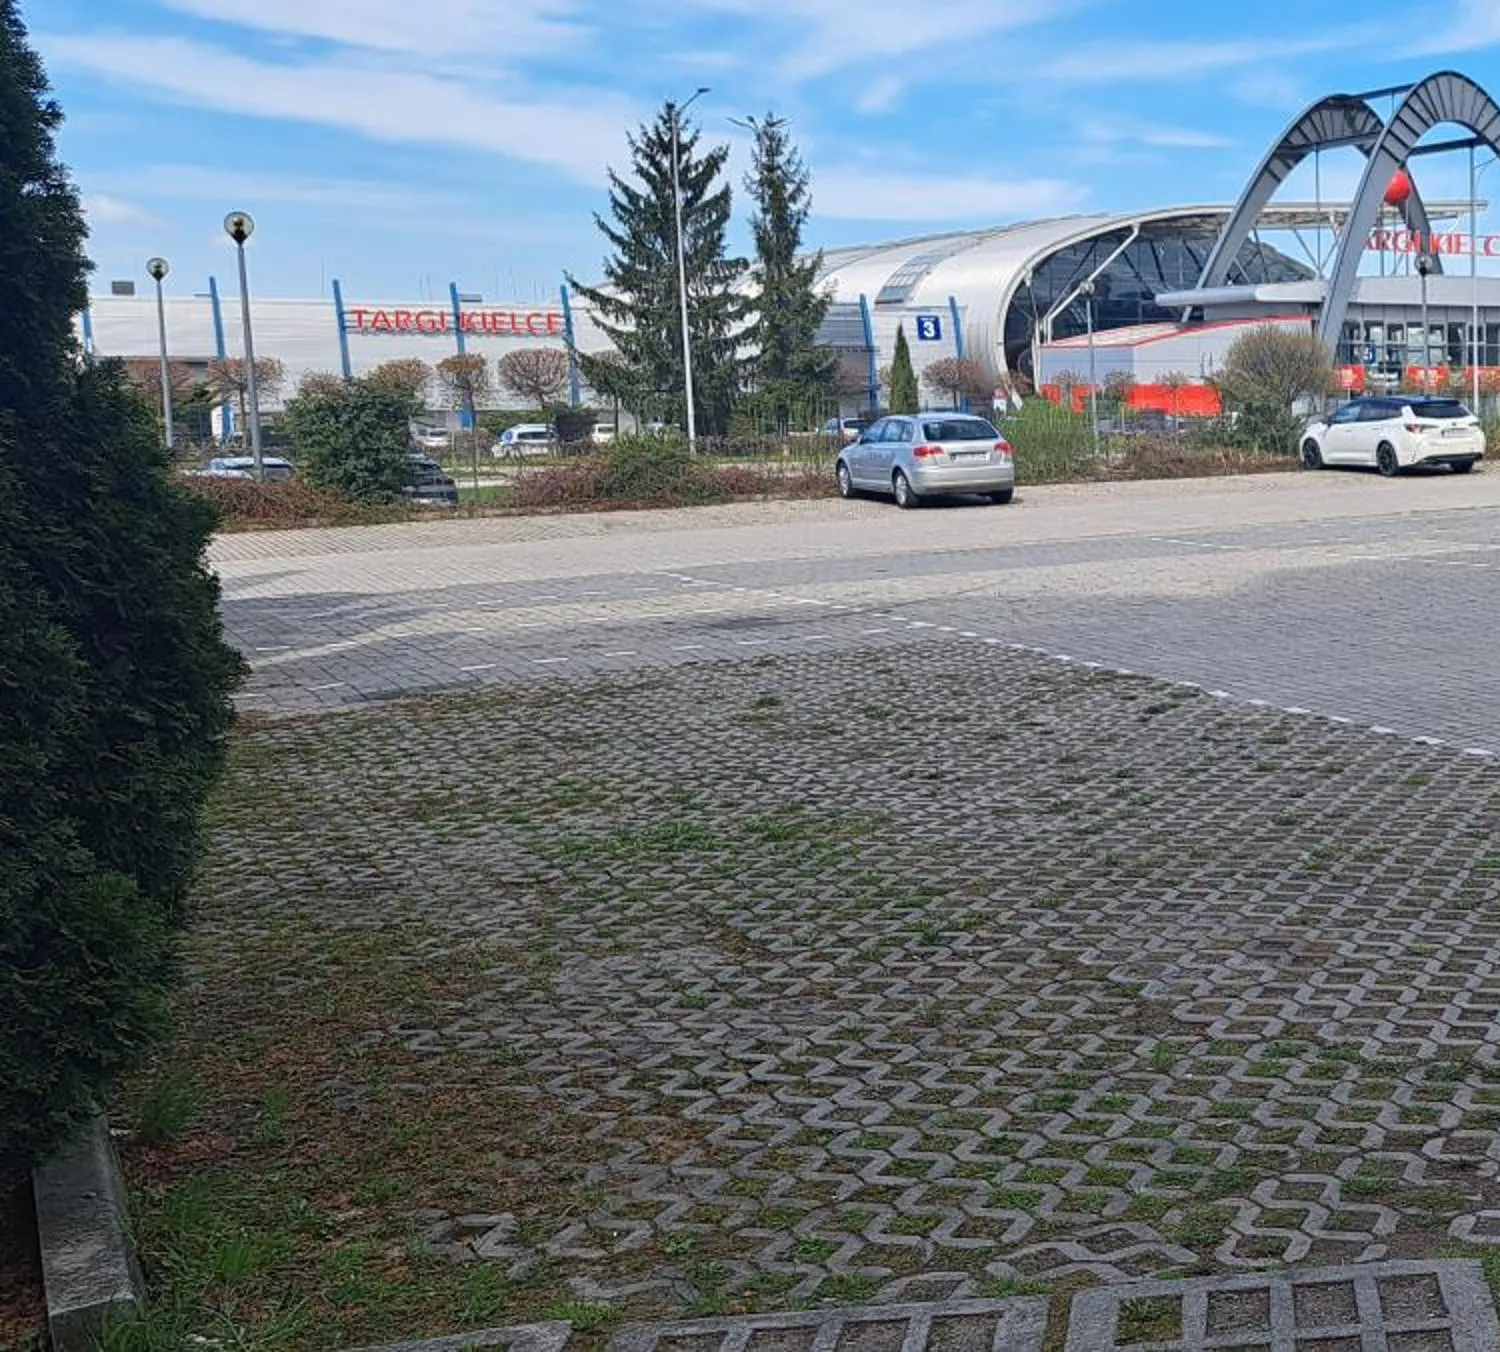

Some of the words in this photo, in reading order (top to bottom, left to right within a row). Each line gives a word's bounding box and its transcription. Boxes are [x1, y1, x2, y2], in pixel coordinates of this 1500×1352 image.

[1365, 228, 1423, 255] ARGI
[350, 309, 447, 332] TARGI
[459, 311, 563, 334] KIELCE
[923, 321, 935, 338] 3
